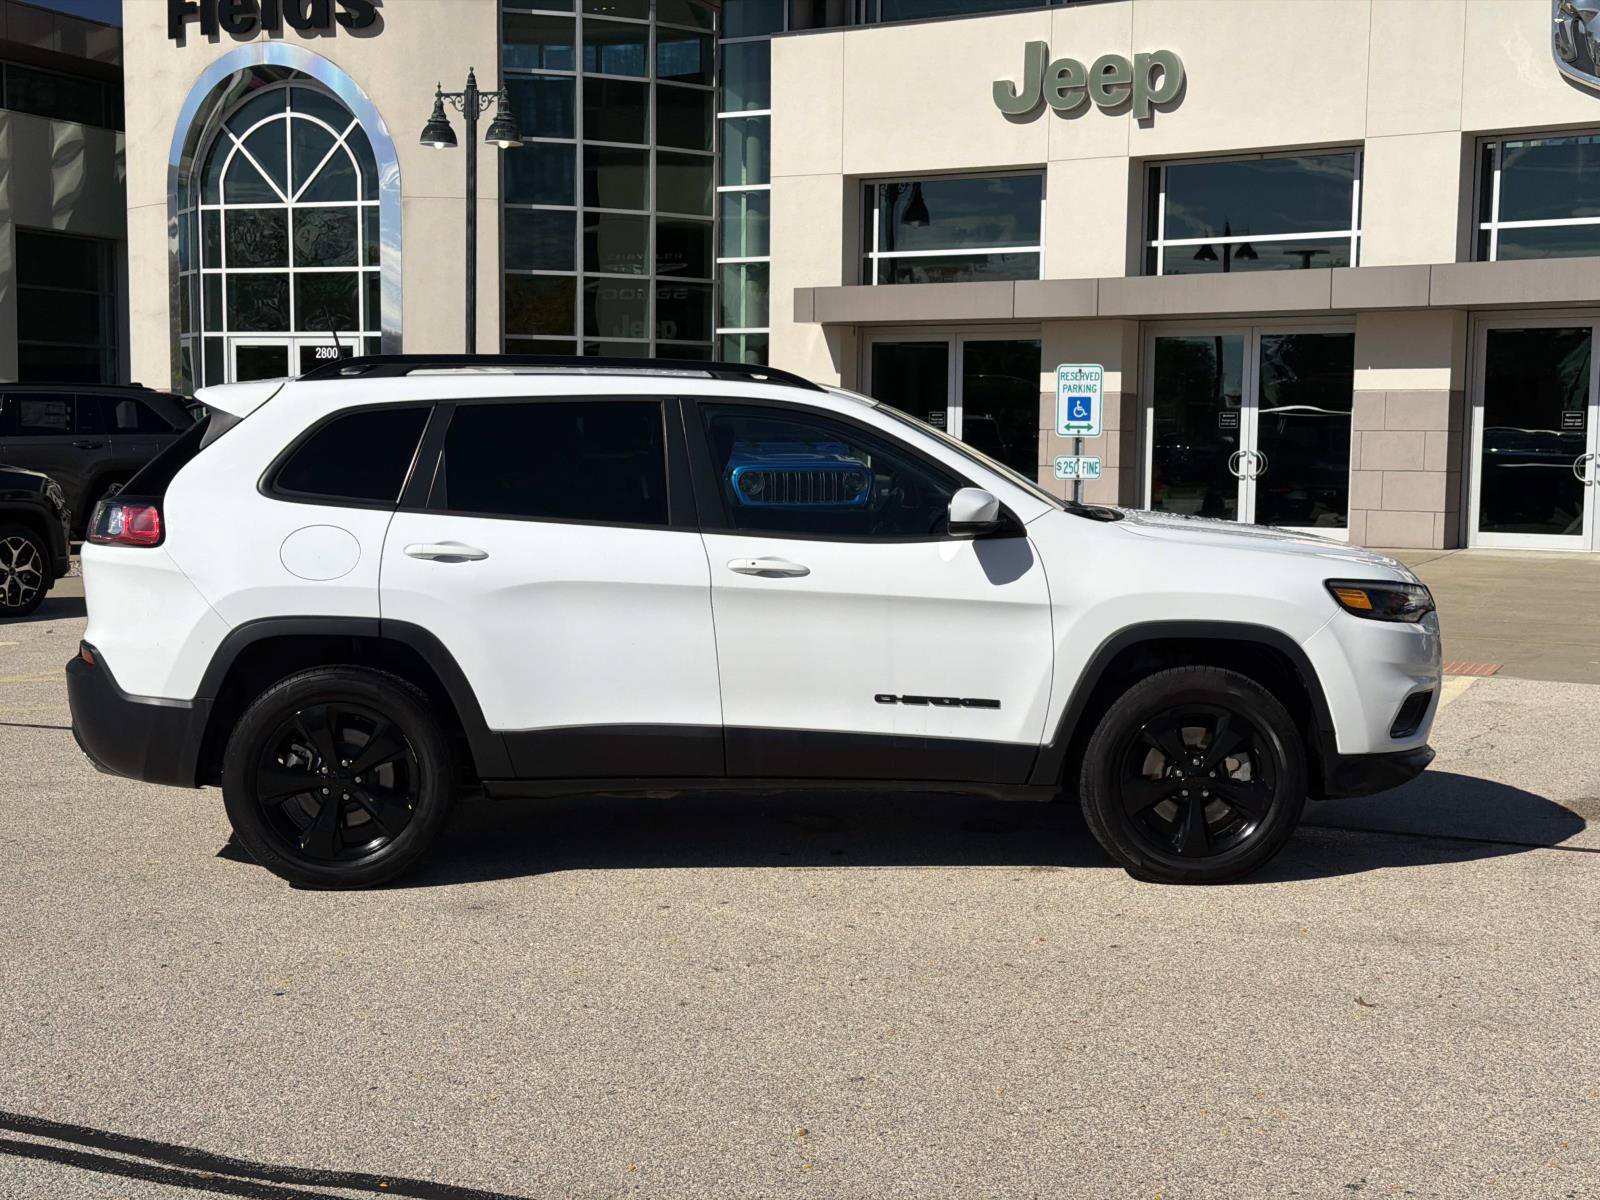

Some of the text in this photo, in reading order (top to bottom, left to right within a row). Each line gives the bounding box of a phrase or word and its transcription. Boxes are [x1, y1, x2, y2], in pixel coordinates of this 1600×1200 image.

[993, 41, 1186, 119] Jeep
[315, 347, 338, 359] 2800
[1060, 371, 1100, 381] RESERVED
[1062, 384, 1097, 393] PARKING
[1082, 461, 1100, 475] FINE
